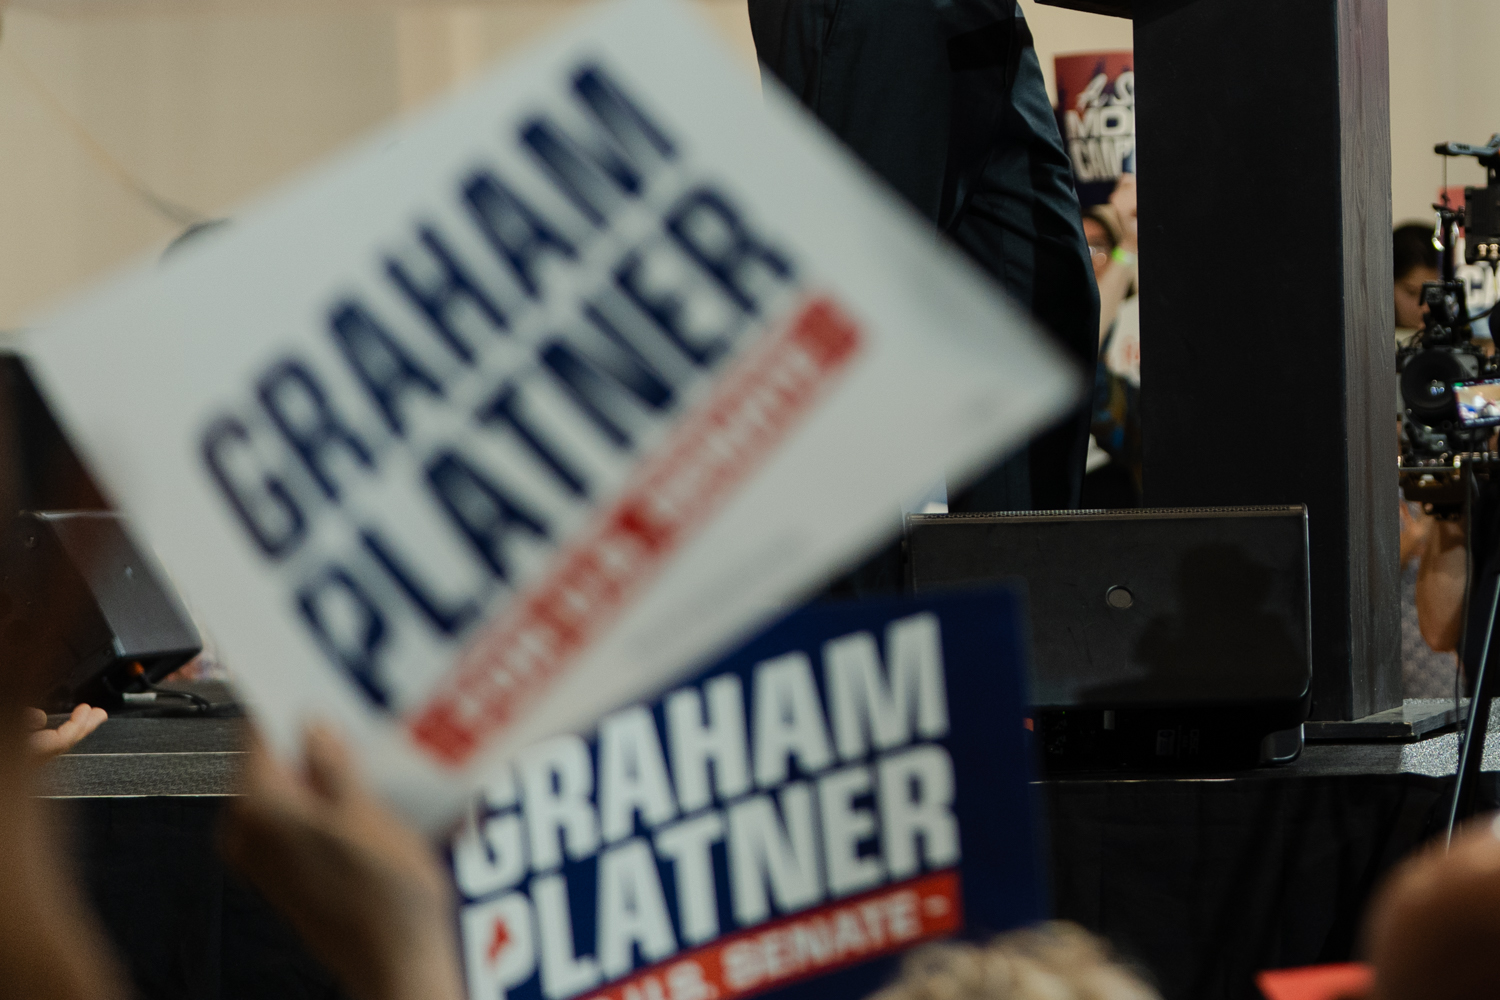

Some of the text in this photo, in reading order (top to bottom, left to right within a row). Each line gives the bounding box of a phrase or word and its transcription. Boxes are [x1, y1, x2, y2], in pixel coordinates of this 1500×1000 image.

[196, 52, 685, 562] GRAHAM
[290, 182, 796, 715] PLATNER
[453, 611, 950, 898] GRAHAM
[460, 743, 961, 1000] PLATNER
[721, 889, 922, 990] SENATE
